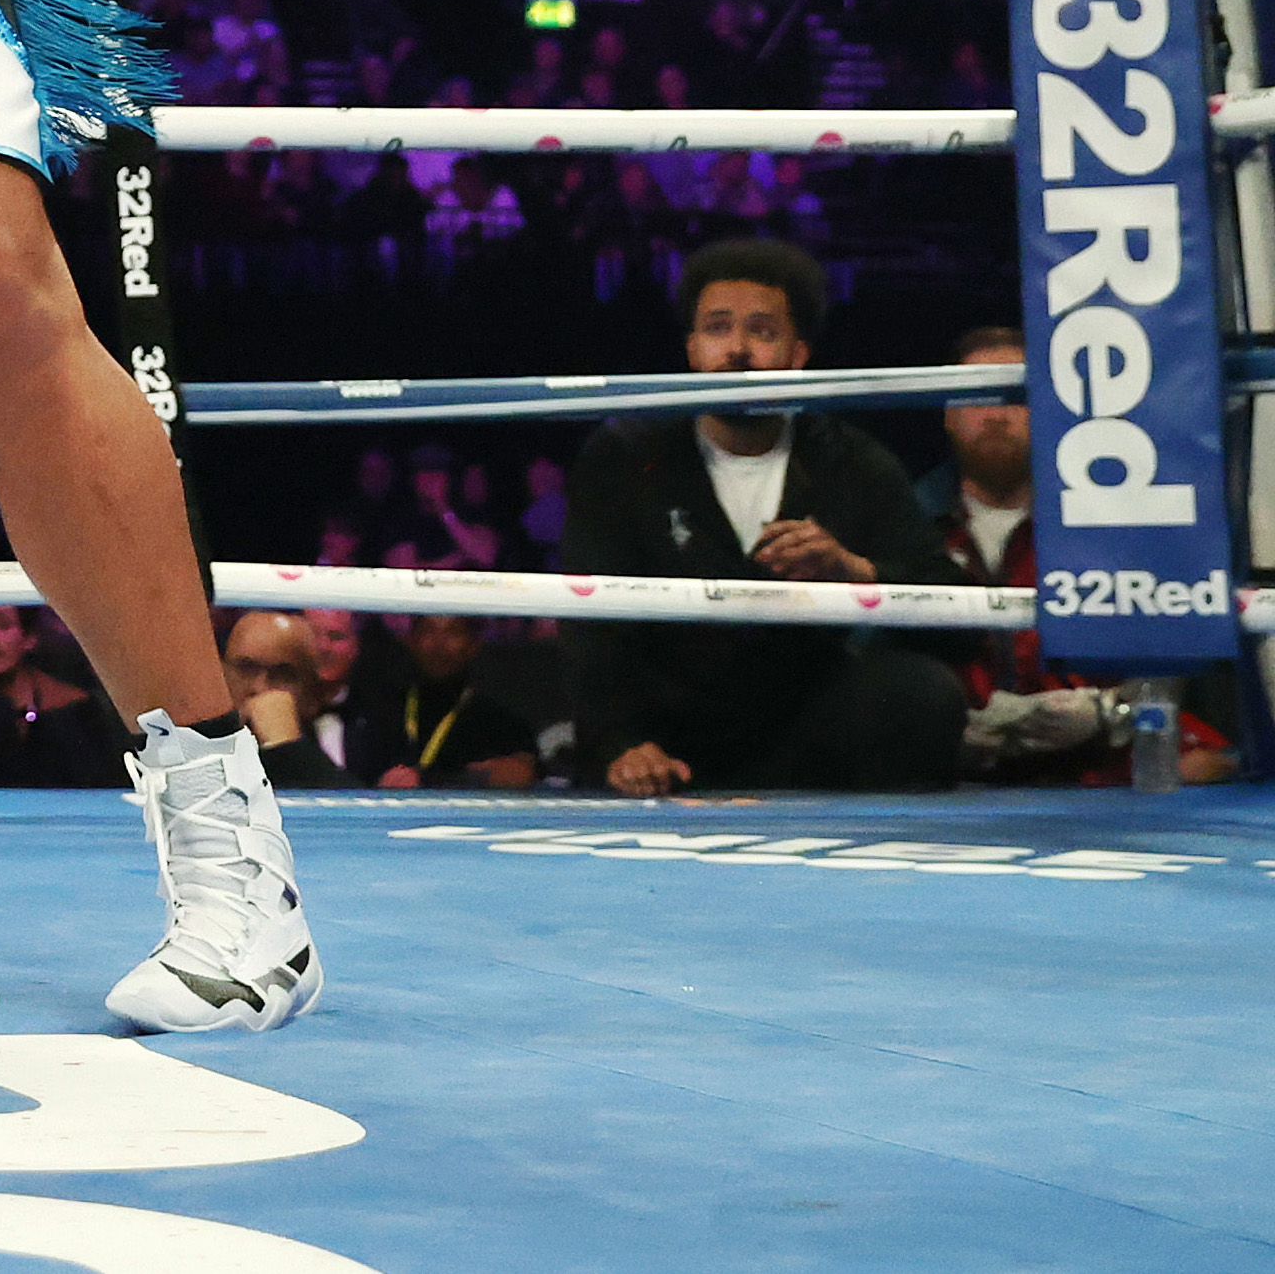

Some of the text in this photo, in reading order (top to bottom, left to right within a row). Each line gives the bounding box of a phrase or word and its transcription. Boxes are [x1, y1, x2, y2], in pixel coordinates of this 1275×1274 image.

[116, 165, 160, 298] 32Red
[132, 345, 182, 466] 32R
[1042, 570, 1230, 616] 32Red
